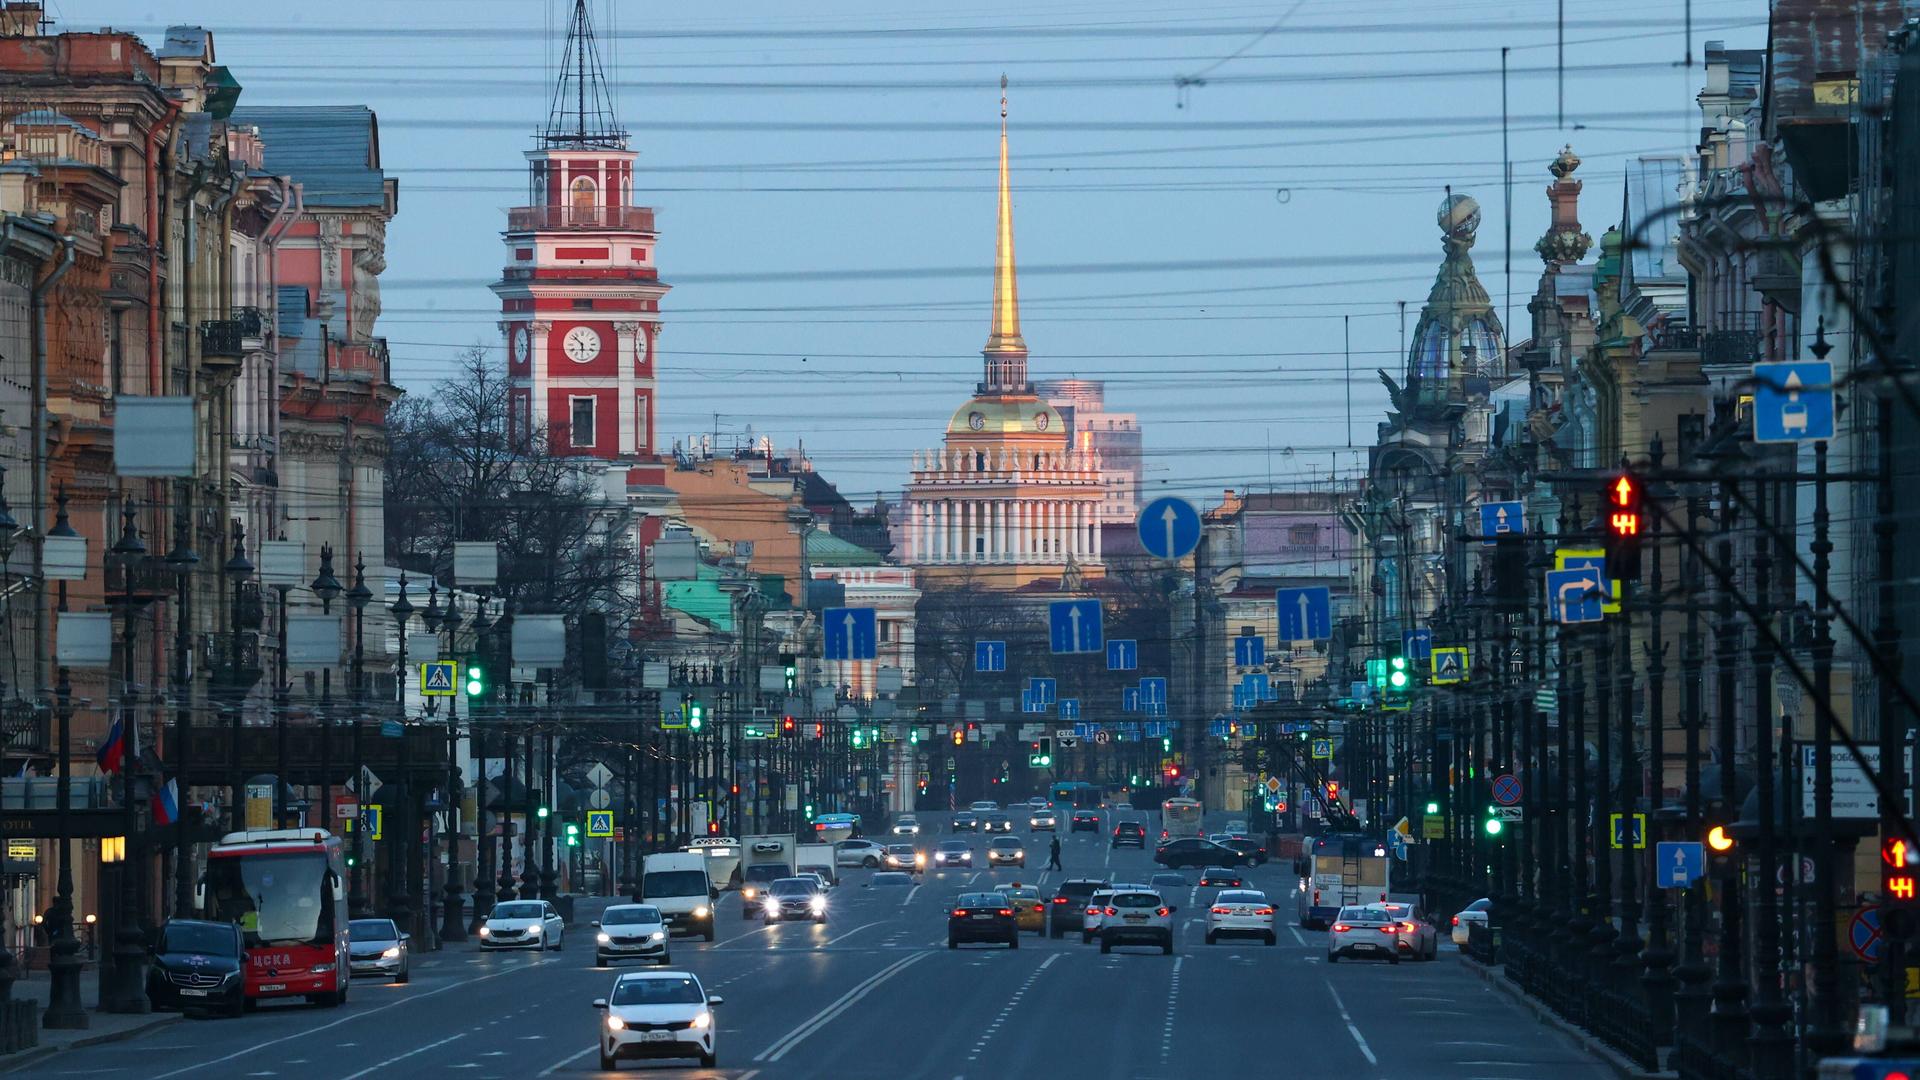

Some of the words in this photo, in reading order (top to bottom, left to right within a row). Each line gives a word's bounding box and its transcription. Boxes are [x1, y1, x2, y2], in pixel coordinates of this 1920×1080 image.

[1612, 513, 1636, 535] 44
[1889, 877, 1913, 898] 44
[253, 953, 291, 967] ЦСКА
